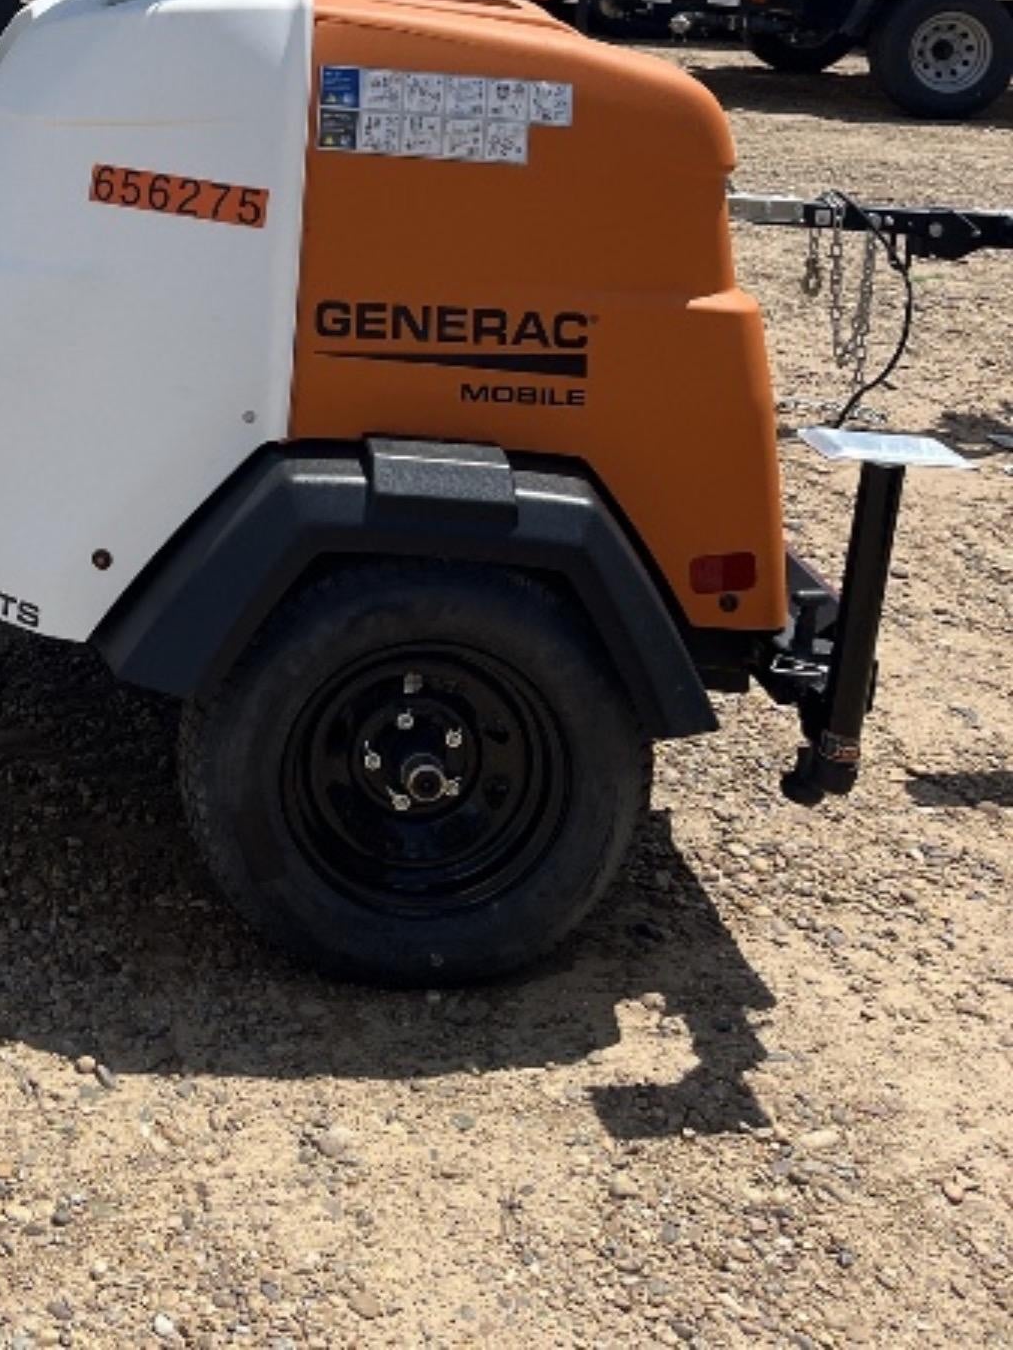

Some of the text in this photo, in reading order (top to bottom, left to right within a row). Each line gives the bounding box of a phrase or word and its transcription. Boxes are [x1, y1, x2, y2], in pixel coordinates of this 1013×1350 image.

[94, 165, 262, 226] 656275
[314, 299, 588, 349] GENERAC
[460, 382, 585, 407] MOBILE
